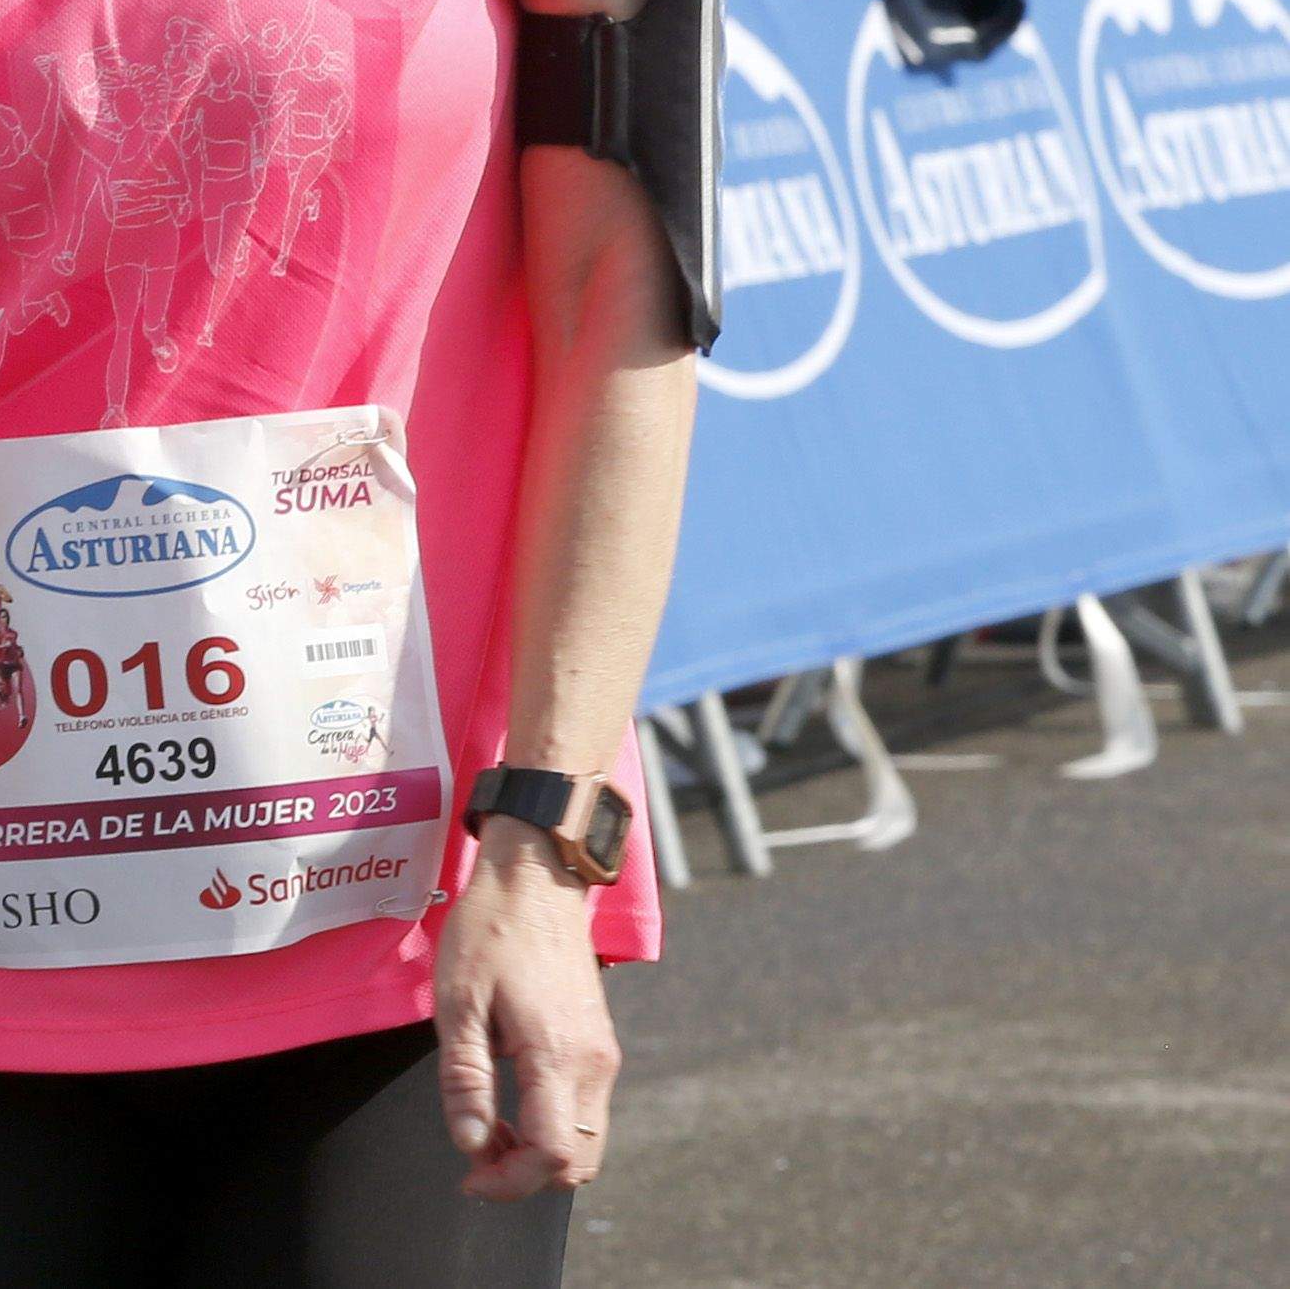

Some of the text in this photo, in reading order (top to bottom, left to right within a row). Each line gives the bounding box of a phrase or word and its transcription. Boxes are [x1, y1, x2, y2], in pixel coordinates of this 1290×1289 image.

[272, 462, 375, 487] TU DORSAL
[274, 481, 373, 515] SUMA
[62, 508, 232, 534] CENTRAL LECHERA
[27, 525, 240, 573] ASTURIANA
[50, 636, 245, 718] 016
[118, 713, 180, 728] VIOLENCIA
[182, 711, 198, 722] DE
[95, 737, 216, 786] 4639
[100, 812, 144, 840] DE
[153, 809, 195, 836] LA
[204, 797, 315, 832] MUJER
[327, 787, 398, 819] 2023
[247, 854, 409, 906] Santander
